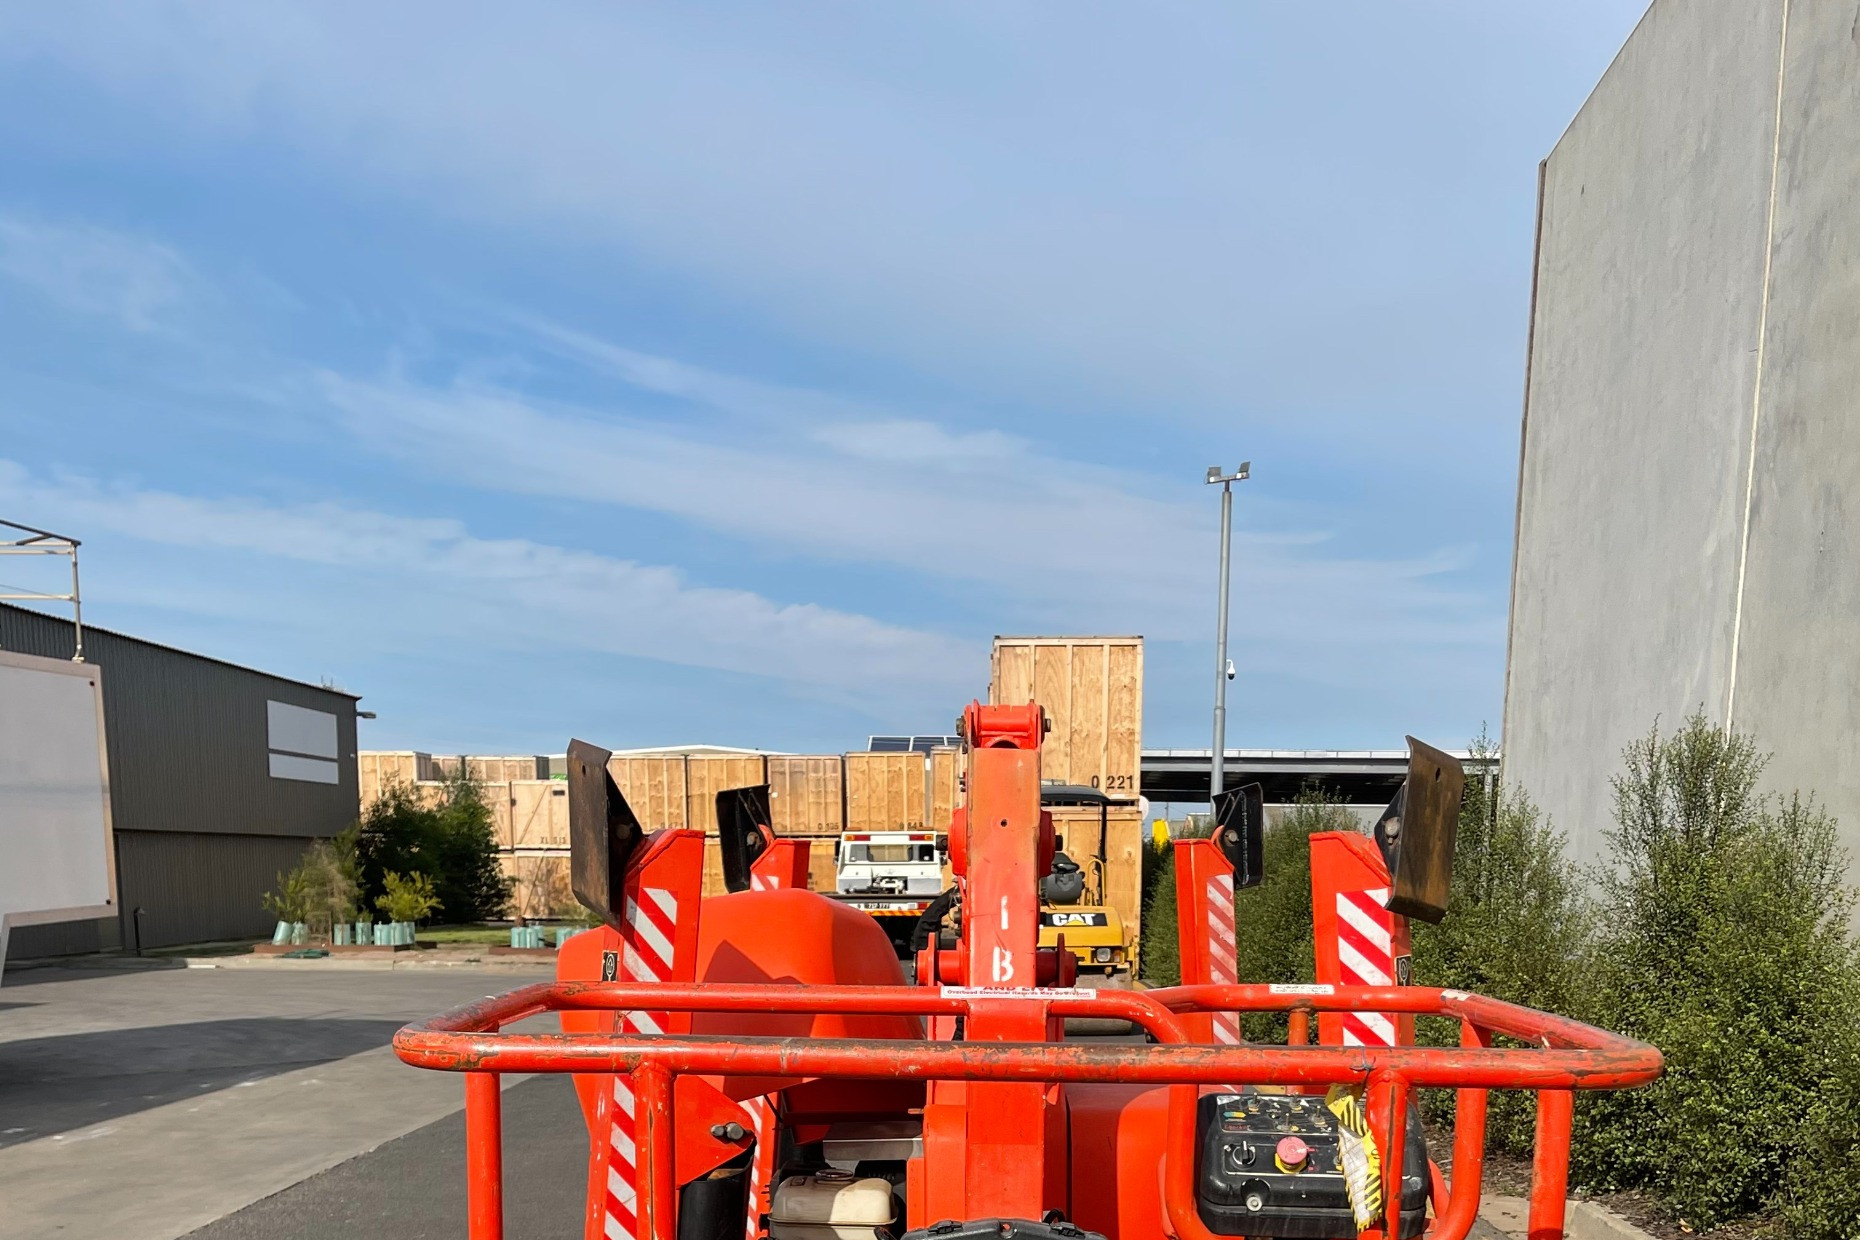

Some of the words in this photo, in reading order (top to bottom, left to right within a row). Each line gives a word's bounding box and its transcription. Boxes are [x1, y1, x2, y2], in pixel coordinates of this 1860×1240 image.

[1092, 775, 1100, 789] 0
[1106, 775, 1134, 789] 221
[1052, 913, 1096, 926] CAT
